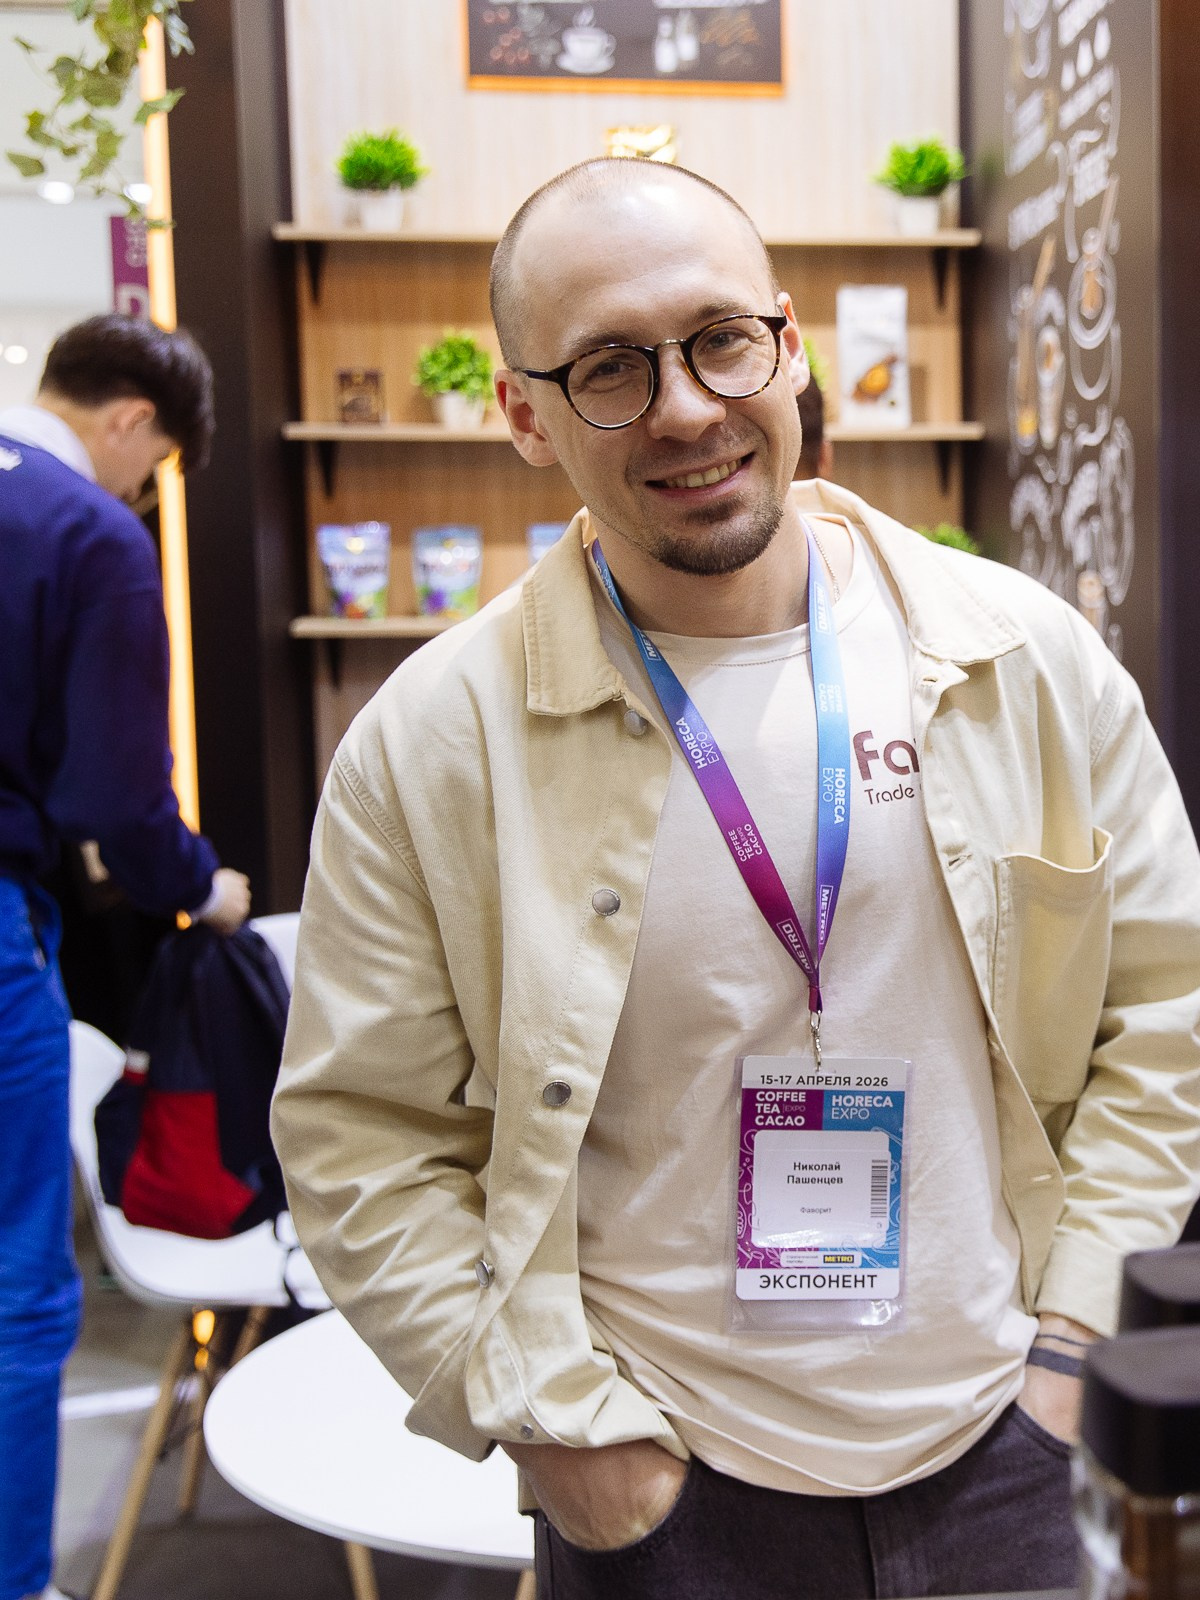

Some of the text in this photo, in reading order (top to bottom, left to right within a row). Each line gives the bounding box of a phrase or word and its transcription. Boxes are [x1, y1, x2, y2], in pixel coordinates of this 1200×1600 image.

[676, 717, 707, 769] HORECA
[697, 731, 719, 765] EXPO
[822, 767, 834, 803] EXPO
[834, 767, 846, 825] HORECA
[864, 783, 915, 805] Trade
[728, 829, 747, 862] COFFEE
[744, 823, 763, 856] CACAO
[743, 841, 755, 858] TEA
[819, 888, 830, 943] METRO
[782, 923, 811, 970] METRO
[760, 1075, 889, 1087] 15-17 АПРЕЛЯ 2026
[756, 1091, 807, 1102] COFFEE
[832, 1095, 893, 1108] HORECA
[755, 1103, 806, 1114] TEA EXPO
[831, 1108, 870, 1120] EXPO
[755, 1115, 805, 1126] CACAO
[793, 1161, 841, 1171] Николай
[787, 1175, 844, 1186] Пашенцев
[824, 1255, 854, 1263] METRO
[759, 1274, 878, 1289] ЭКСПОНЕНТ
